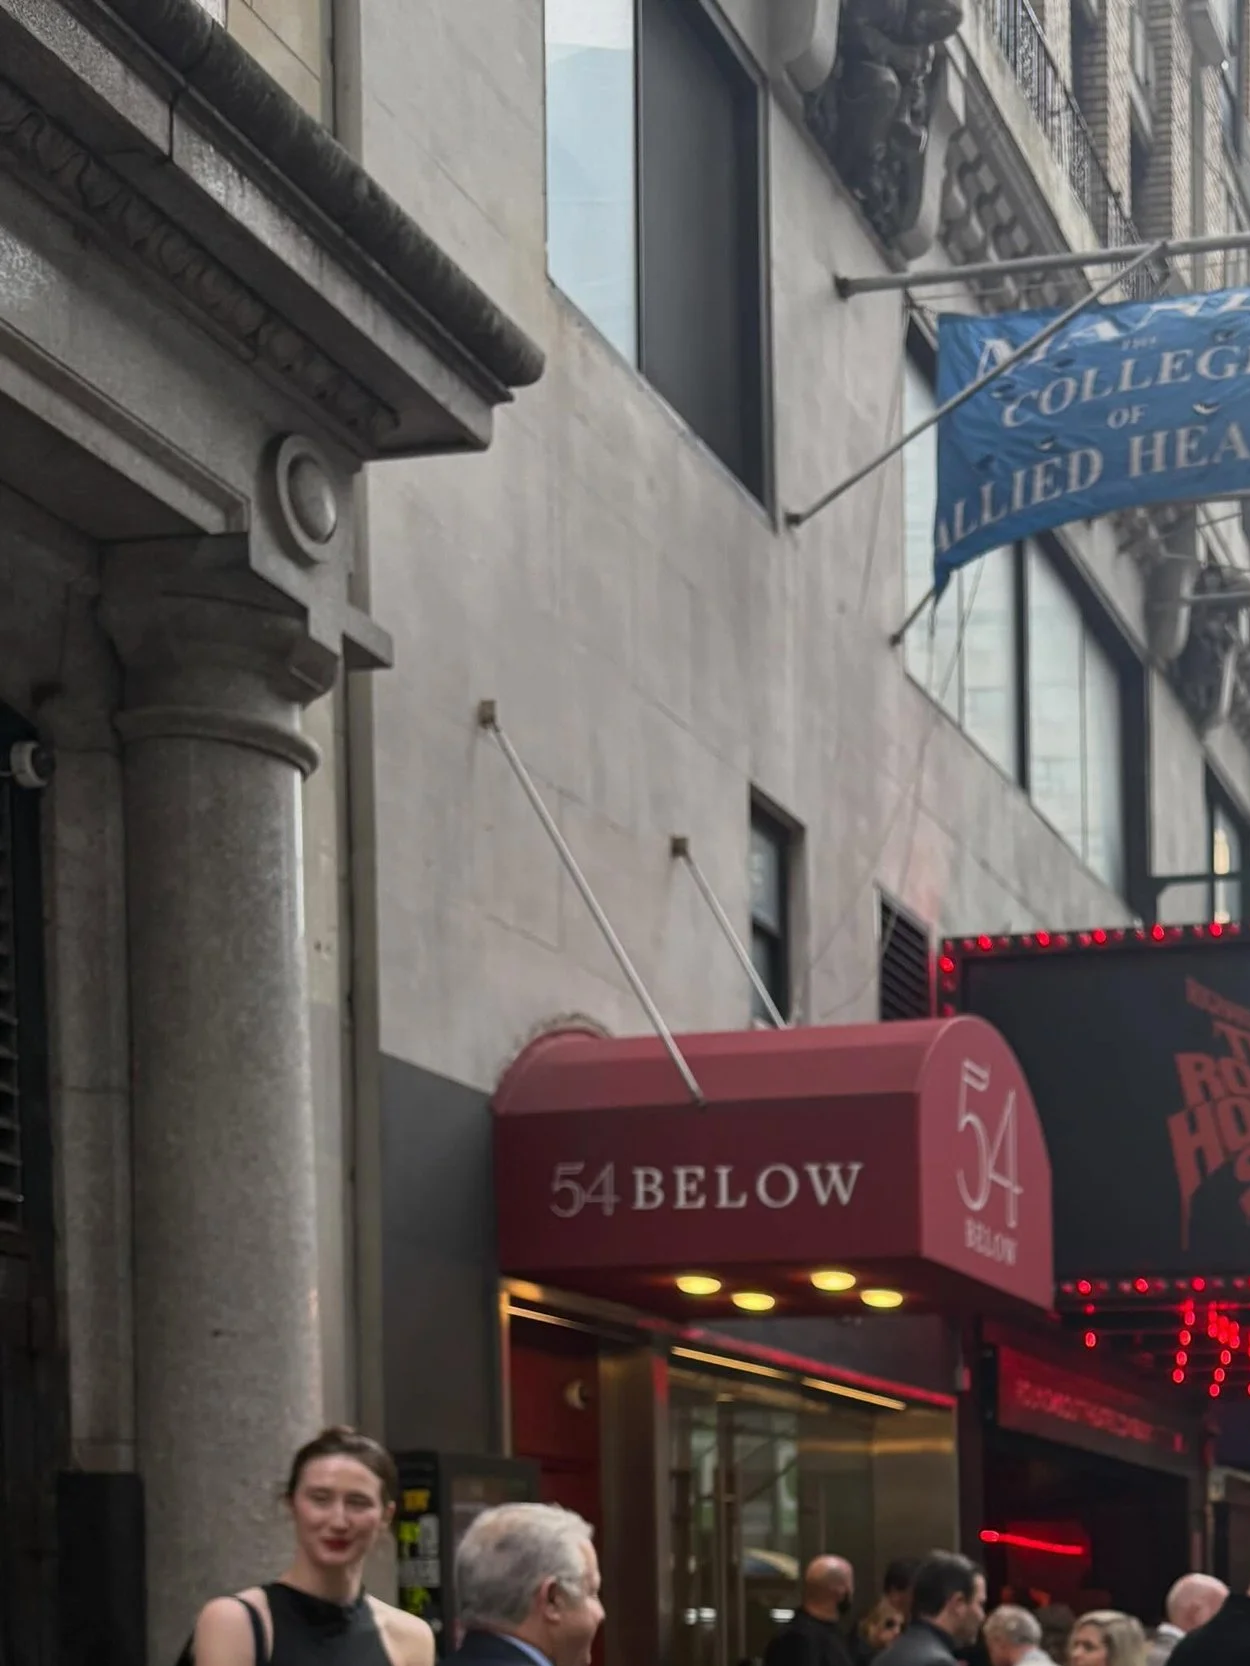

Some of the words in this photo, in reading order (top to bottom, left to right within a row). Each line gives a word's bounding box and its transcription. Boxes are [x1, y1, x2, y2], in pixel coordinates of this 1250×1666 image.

[1107, 402, 1149, 430] OF
[938, 447, 1104, 552] ALLIED
[957, 1057, 1024, 1229] 54
[550, 1160, 621, 1218] 54
[632, 1161, 864, 1210] BELOW
[965, 1216, 1018, 1267] BELOW
